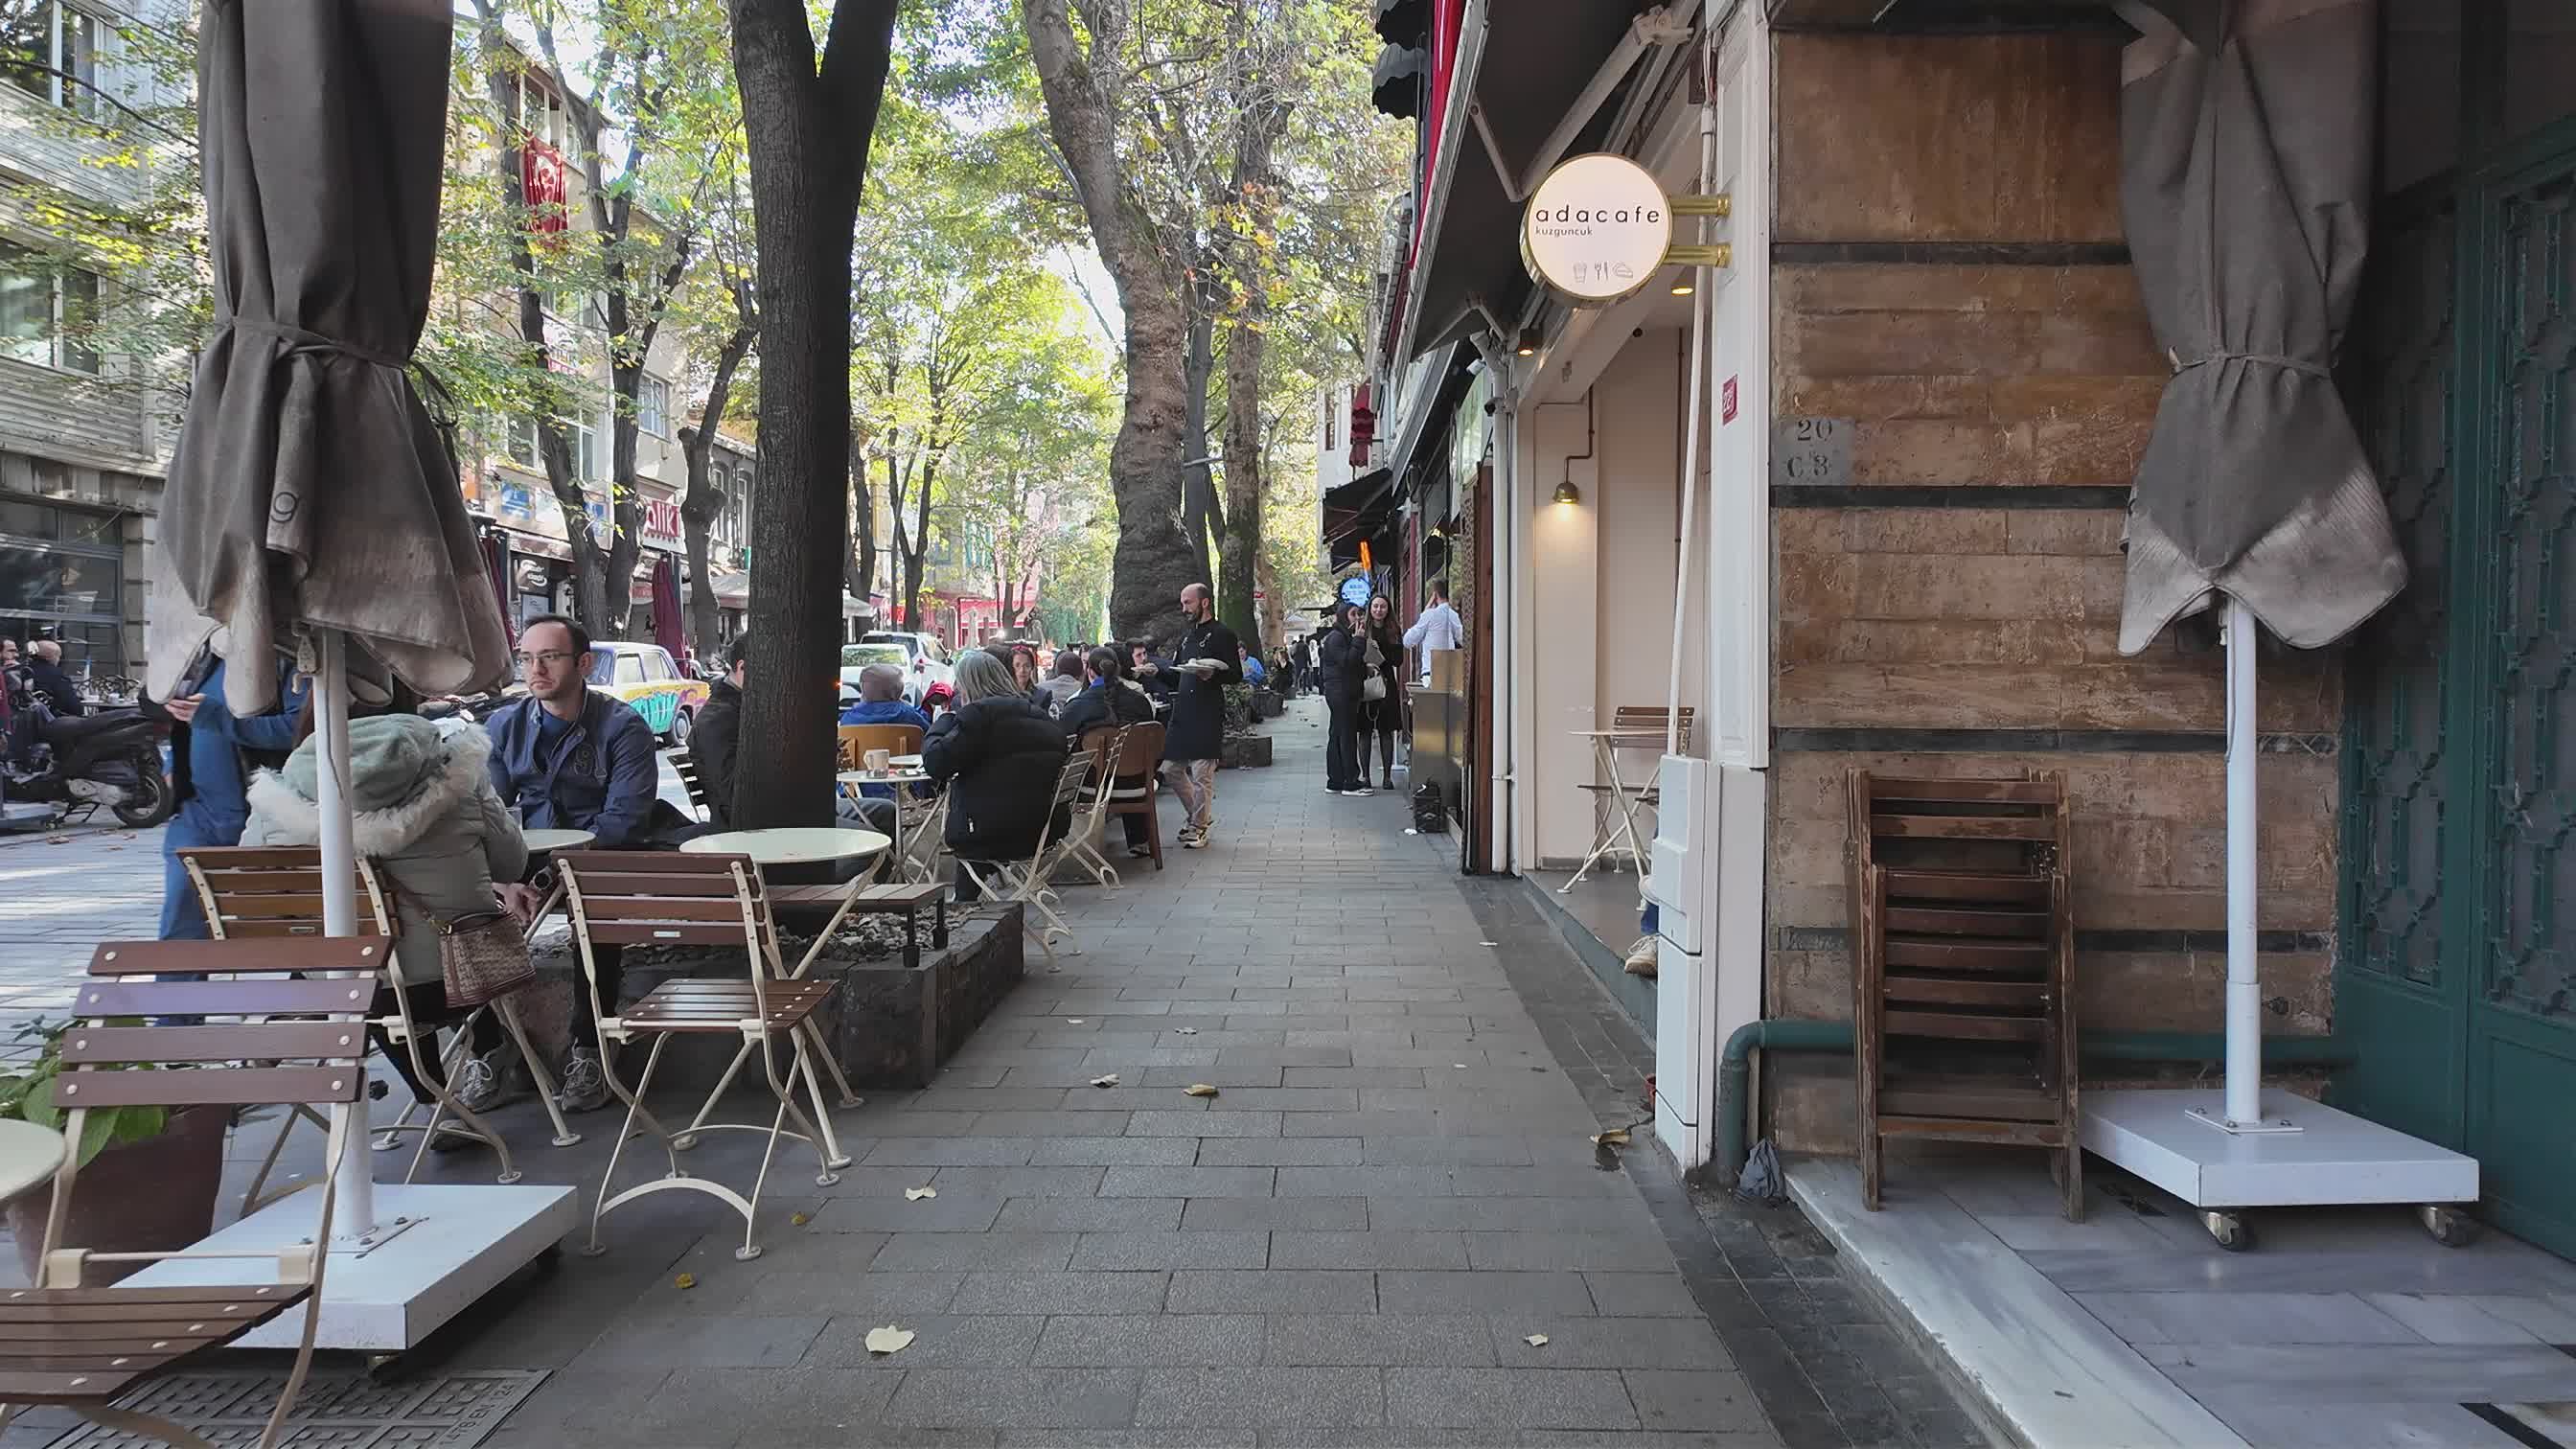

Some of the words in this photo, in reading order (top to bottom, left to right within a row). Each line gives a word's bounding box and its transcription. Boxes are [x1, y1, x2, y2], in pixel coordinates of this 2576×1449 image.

[1536, 204, 1659, 222] adacafe
[1535, 226, 1593, 238] kuzguncuk
[1797, 420, 1832, 441] 20
